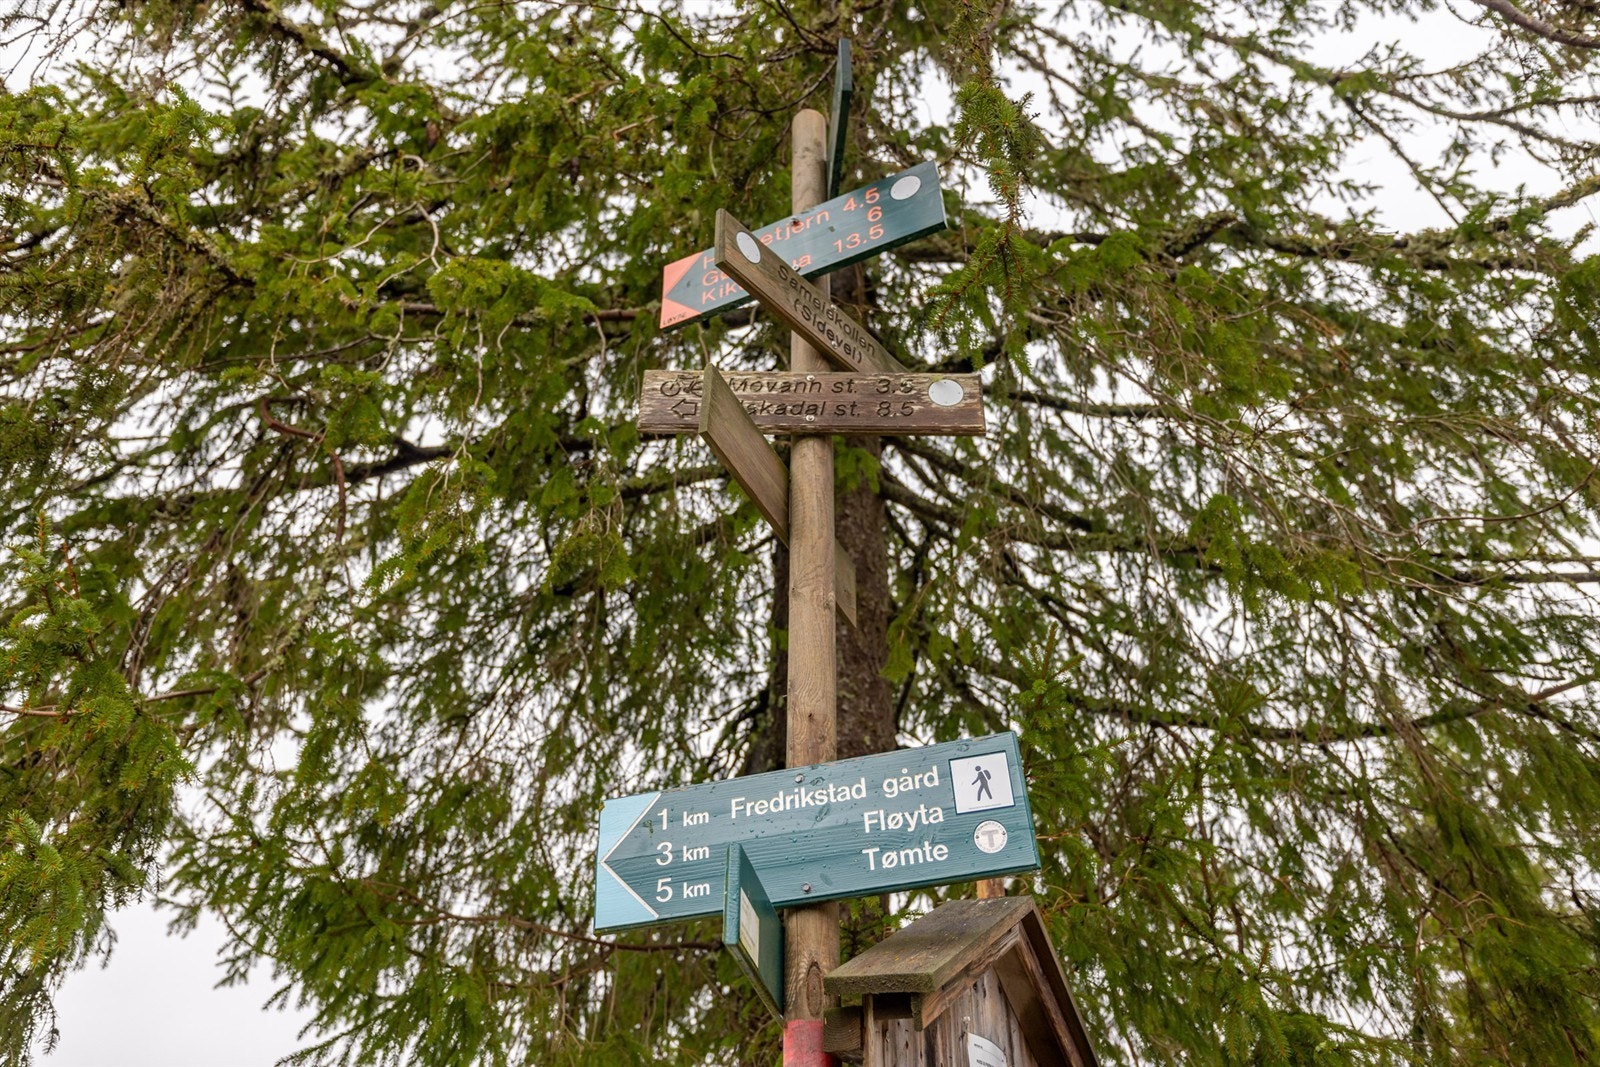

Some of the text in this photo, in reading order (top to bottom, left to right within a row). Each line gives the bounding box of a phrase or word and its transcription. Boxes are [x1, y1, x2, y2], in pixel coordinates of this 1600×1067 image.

[843, 187, 880, 211] 4.5
[867, 206, 883, 222] 6
[833, 224, 884, 253] 13.5
[832, 379, 857, 394] st.
[834, 401, 860, 417] st.
[657, 765, 940, 830] 1 km Fredrikstad gård
[656, 804, 945, 866] 3 km Fløyta
[656, 841, 949, 902] 5 km Tømte
